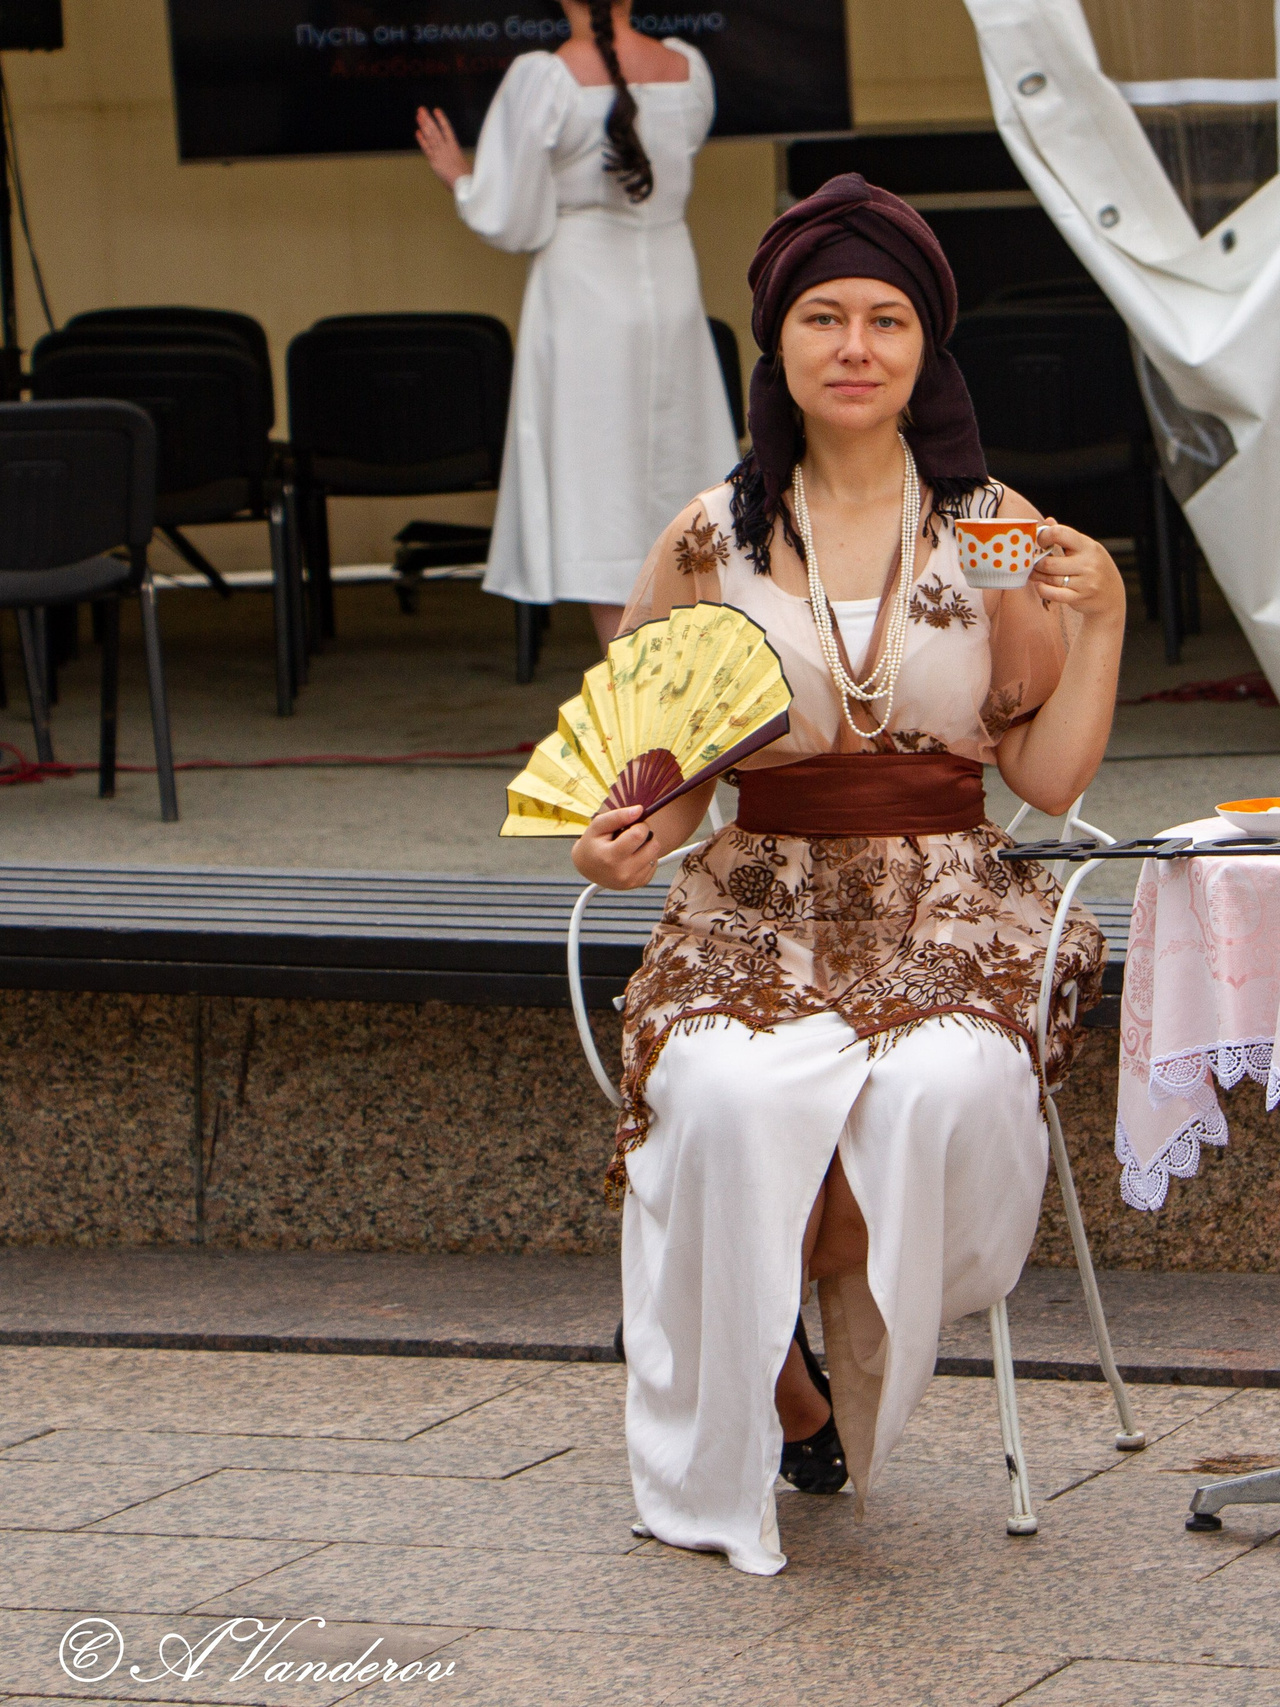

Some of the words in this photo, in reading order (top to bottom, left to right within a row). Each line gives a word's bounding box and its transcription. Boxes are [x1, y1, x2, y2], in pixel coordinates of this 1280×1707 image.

[296, 23, 368, 49] Пусть
[373, 25, 406, 44] он
[413, 22, 498, 44] землю
